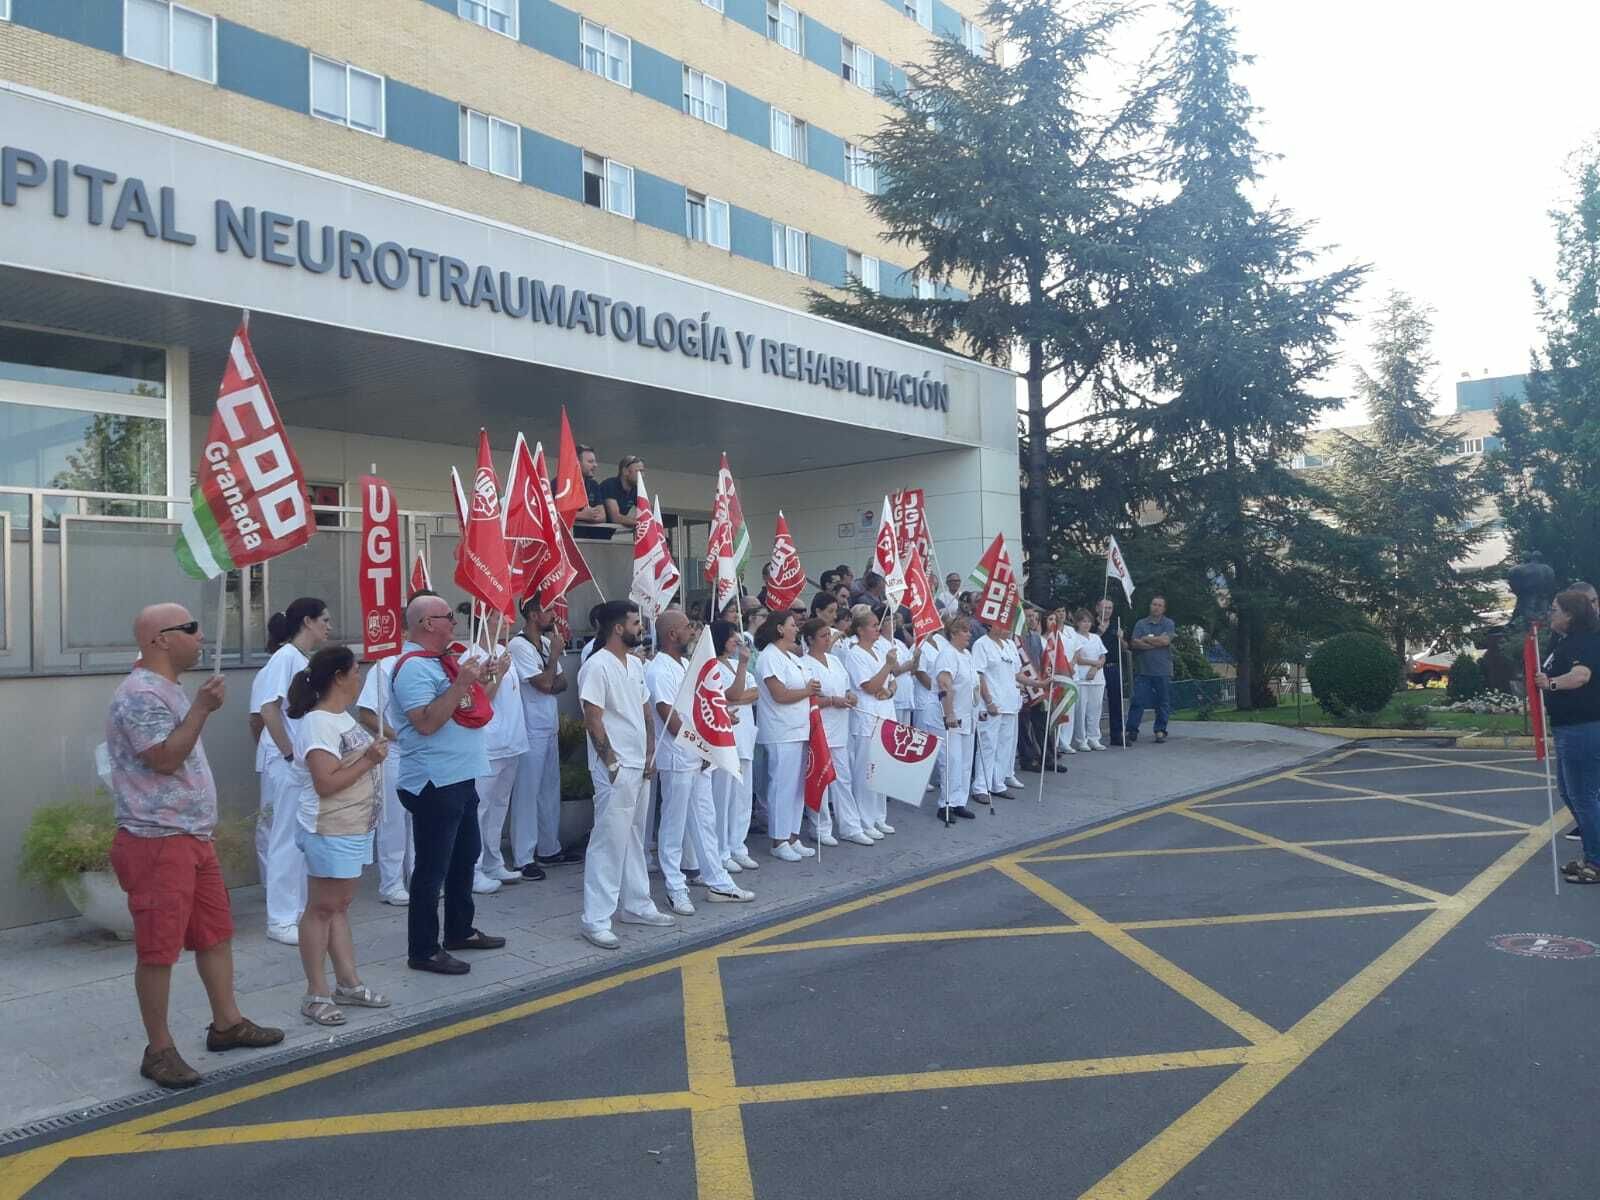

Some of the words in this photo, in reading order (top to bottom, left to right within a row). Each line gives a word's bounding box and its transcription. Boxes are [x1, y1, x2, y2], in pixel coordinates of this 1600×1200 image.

[215, 198, 733, 366] NEUROTRAUMATOLOGÍA
[735, 330, 757, 370] Y
[760, 337, 950, 414] REHABILITACIÓN
[204, 440, 263, 551] Granada
[367, 483, 393, 607] UGT
